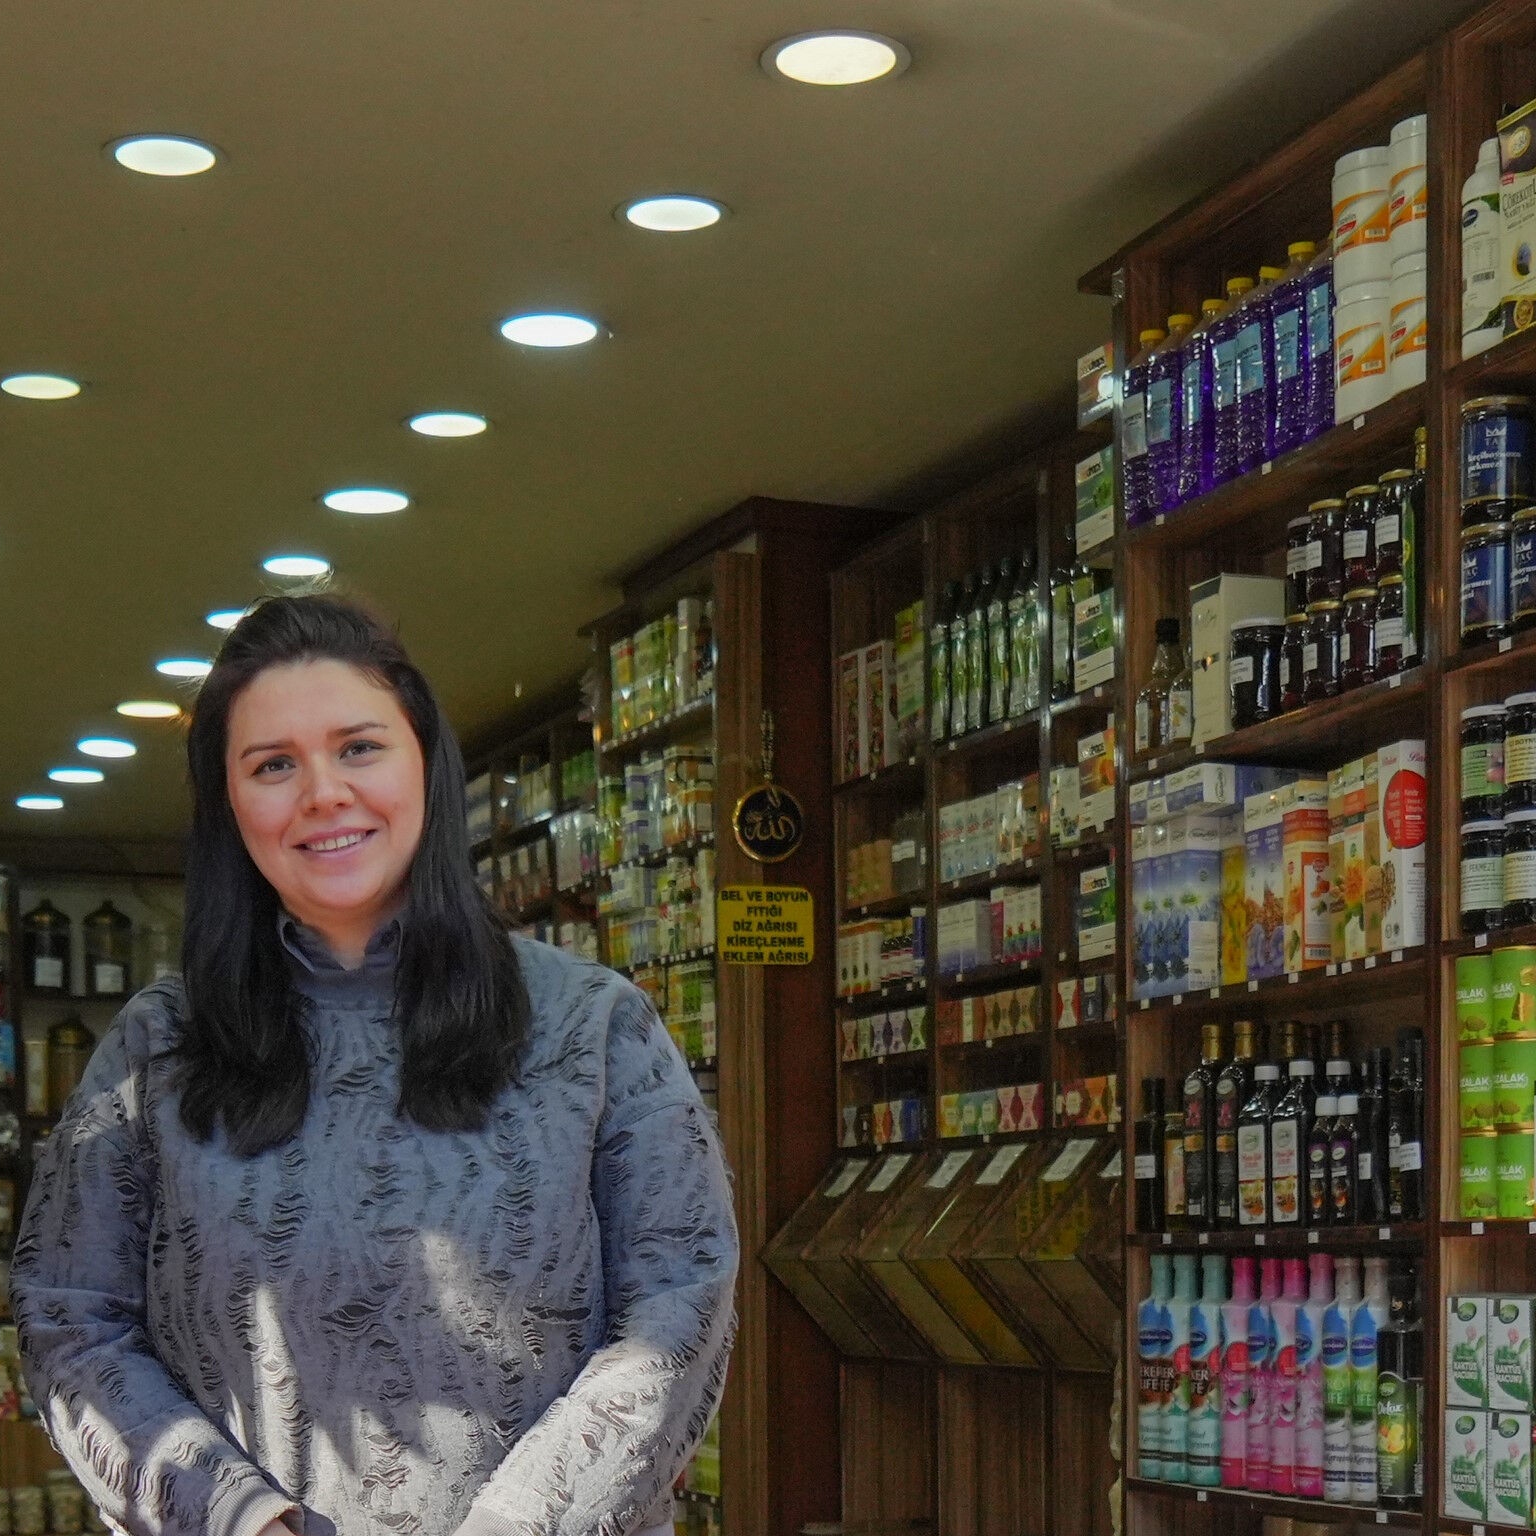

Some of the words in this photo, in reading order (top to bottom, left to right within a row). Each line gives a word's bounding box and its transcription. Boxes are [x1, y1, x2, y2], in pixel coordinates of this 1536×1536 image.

[721, 890, 743, 902] BEL
[746, 891, 763, 902] VE
[766, 891, 809, 903] BOYUN
[747, 904, 782, 917] FITIĞI
[733, 919, 753, 932] DİZ
[756, 919, 798, 932] AĞRISI
[726, 934, 805, 950] KİREÇLENME
[723, 951, 764, 963] EKLEM
[768, 949, 809, 963] AĞRISI
